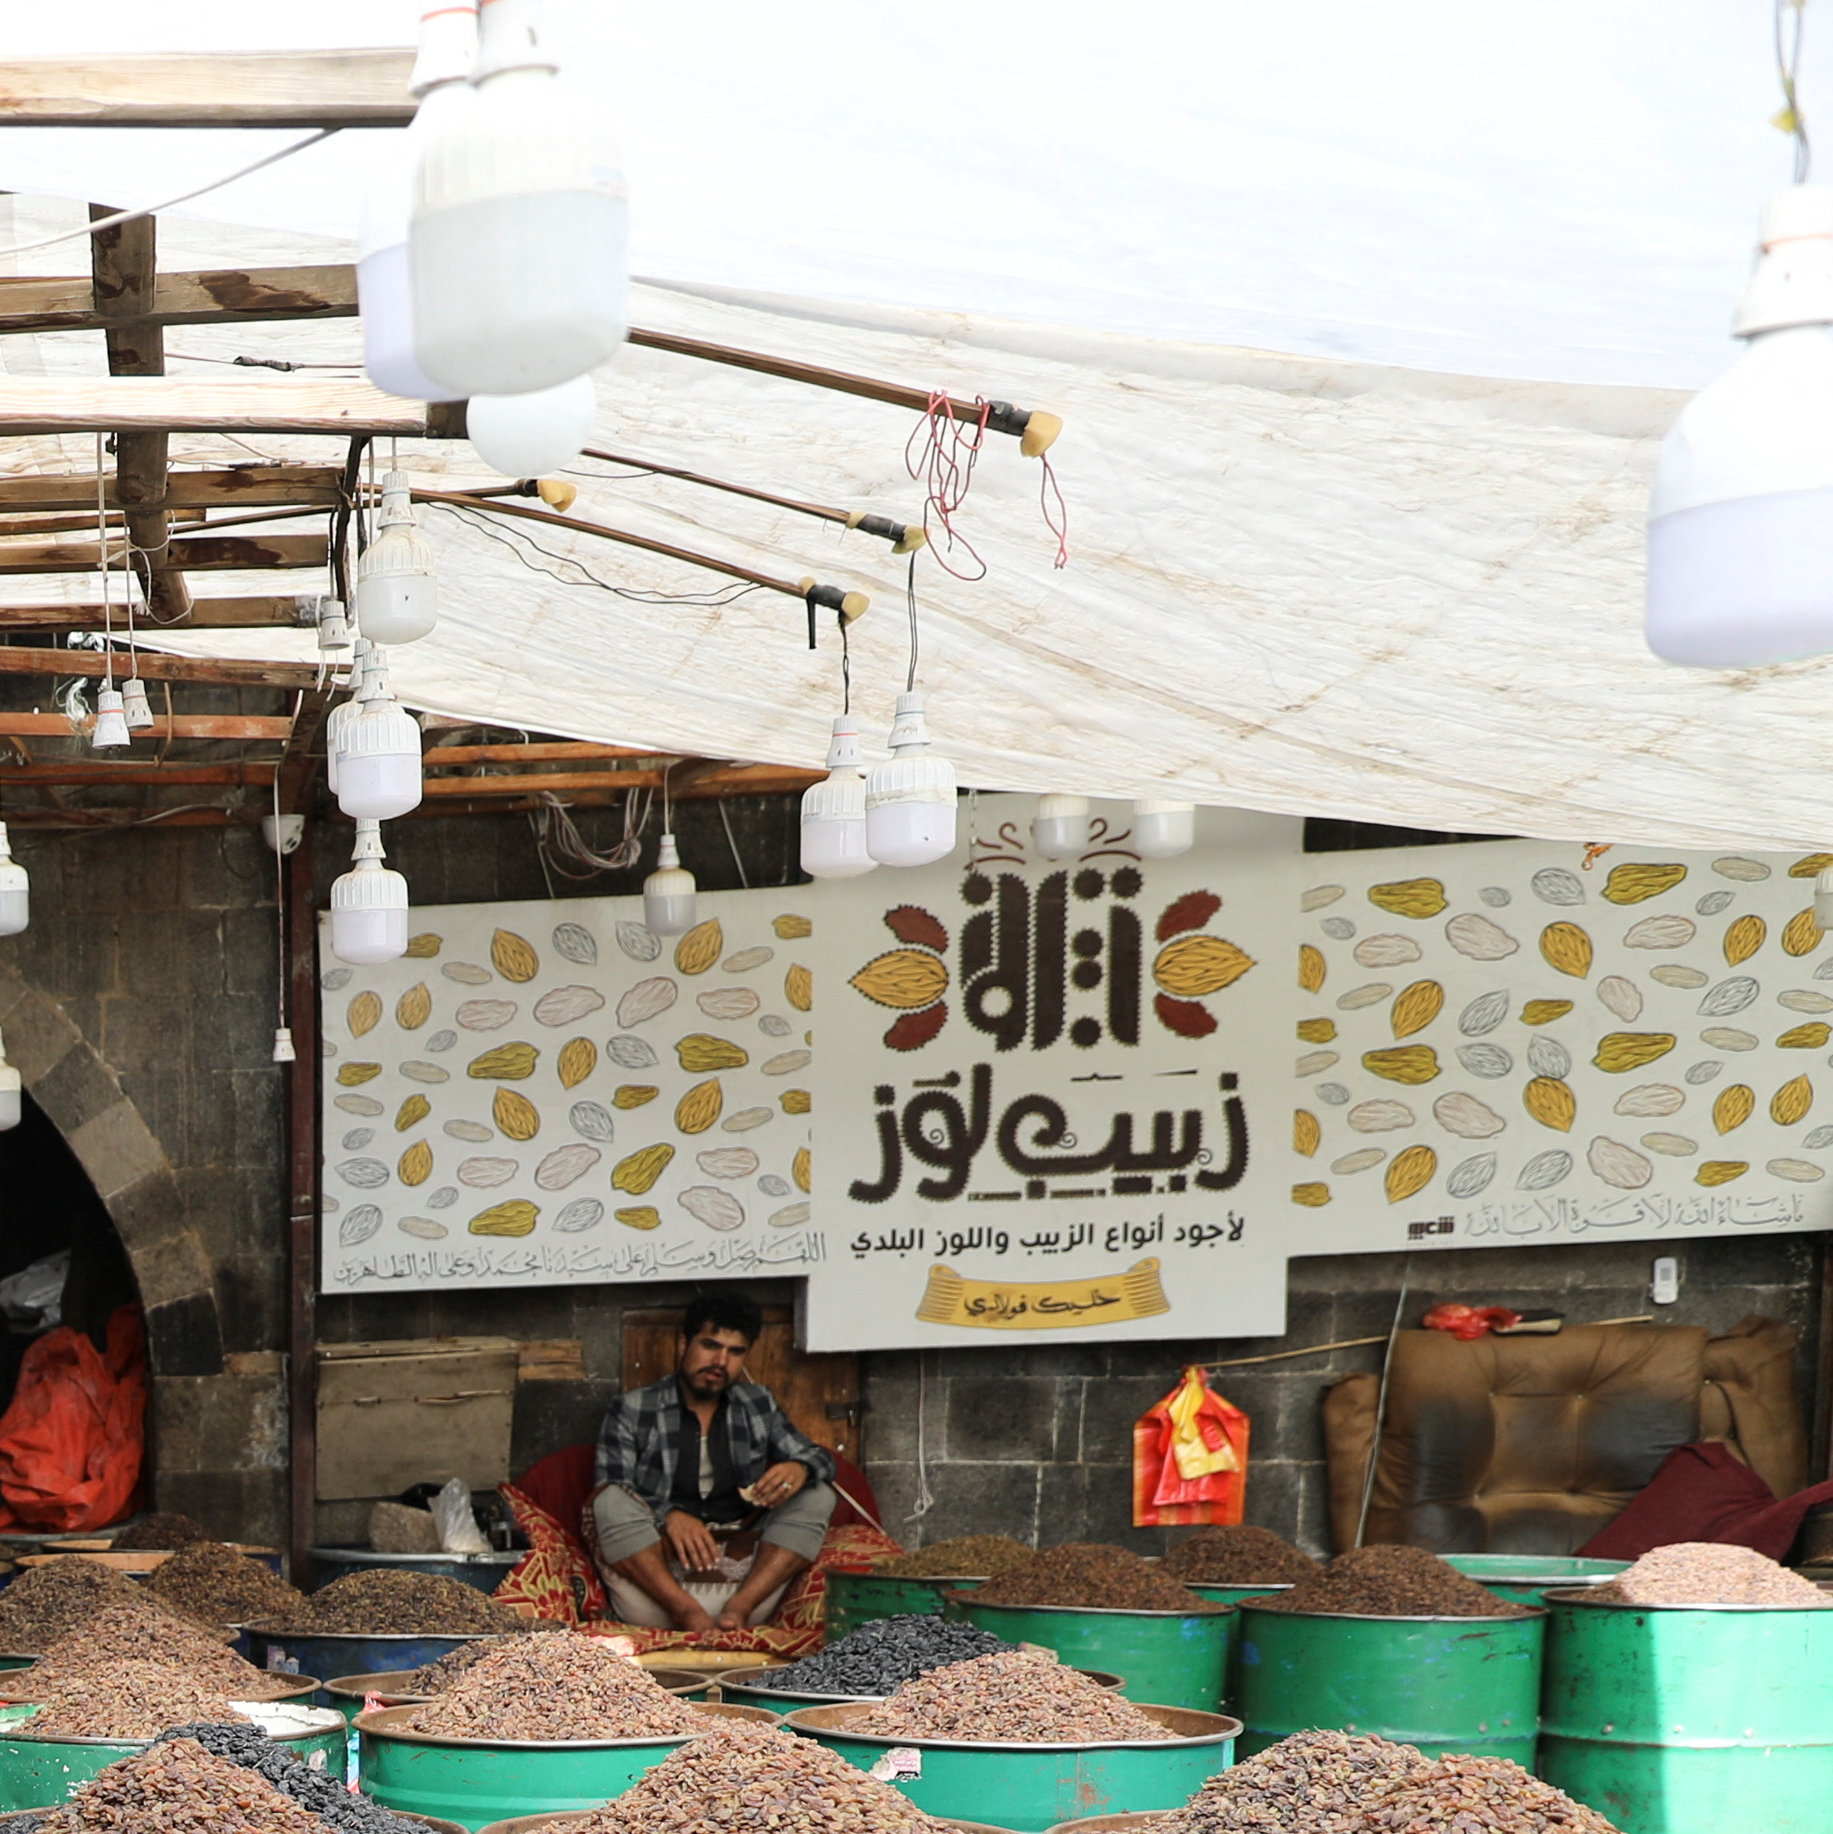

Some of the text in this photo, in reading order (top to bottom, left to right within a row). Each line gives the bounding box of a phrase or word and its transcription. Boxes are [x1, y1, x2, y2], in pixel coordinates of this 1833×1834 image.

[996, 1071, 1249, 1199] زبيب
[850, 1211, 1245, 1259] لأجود أنواع الزبيب واللوز البلدي
